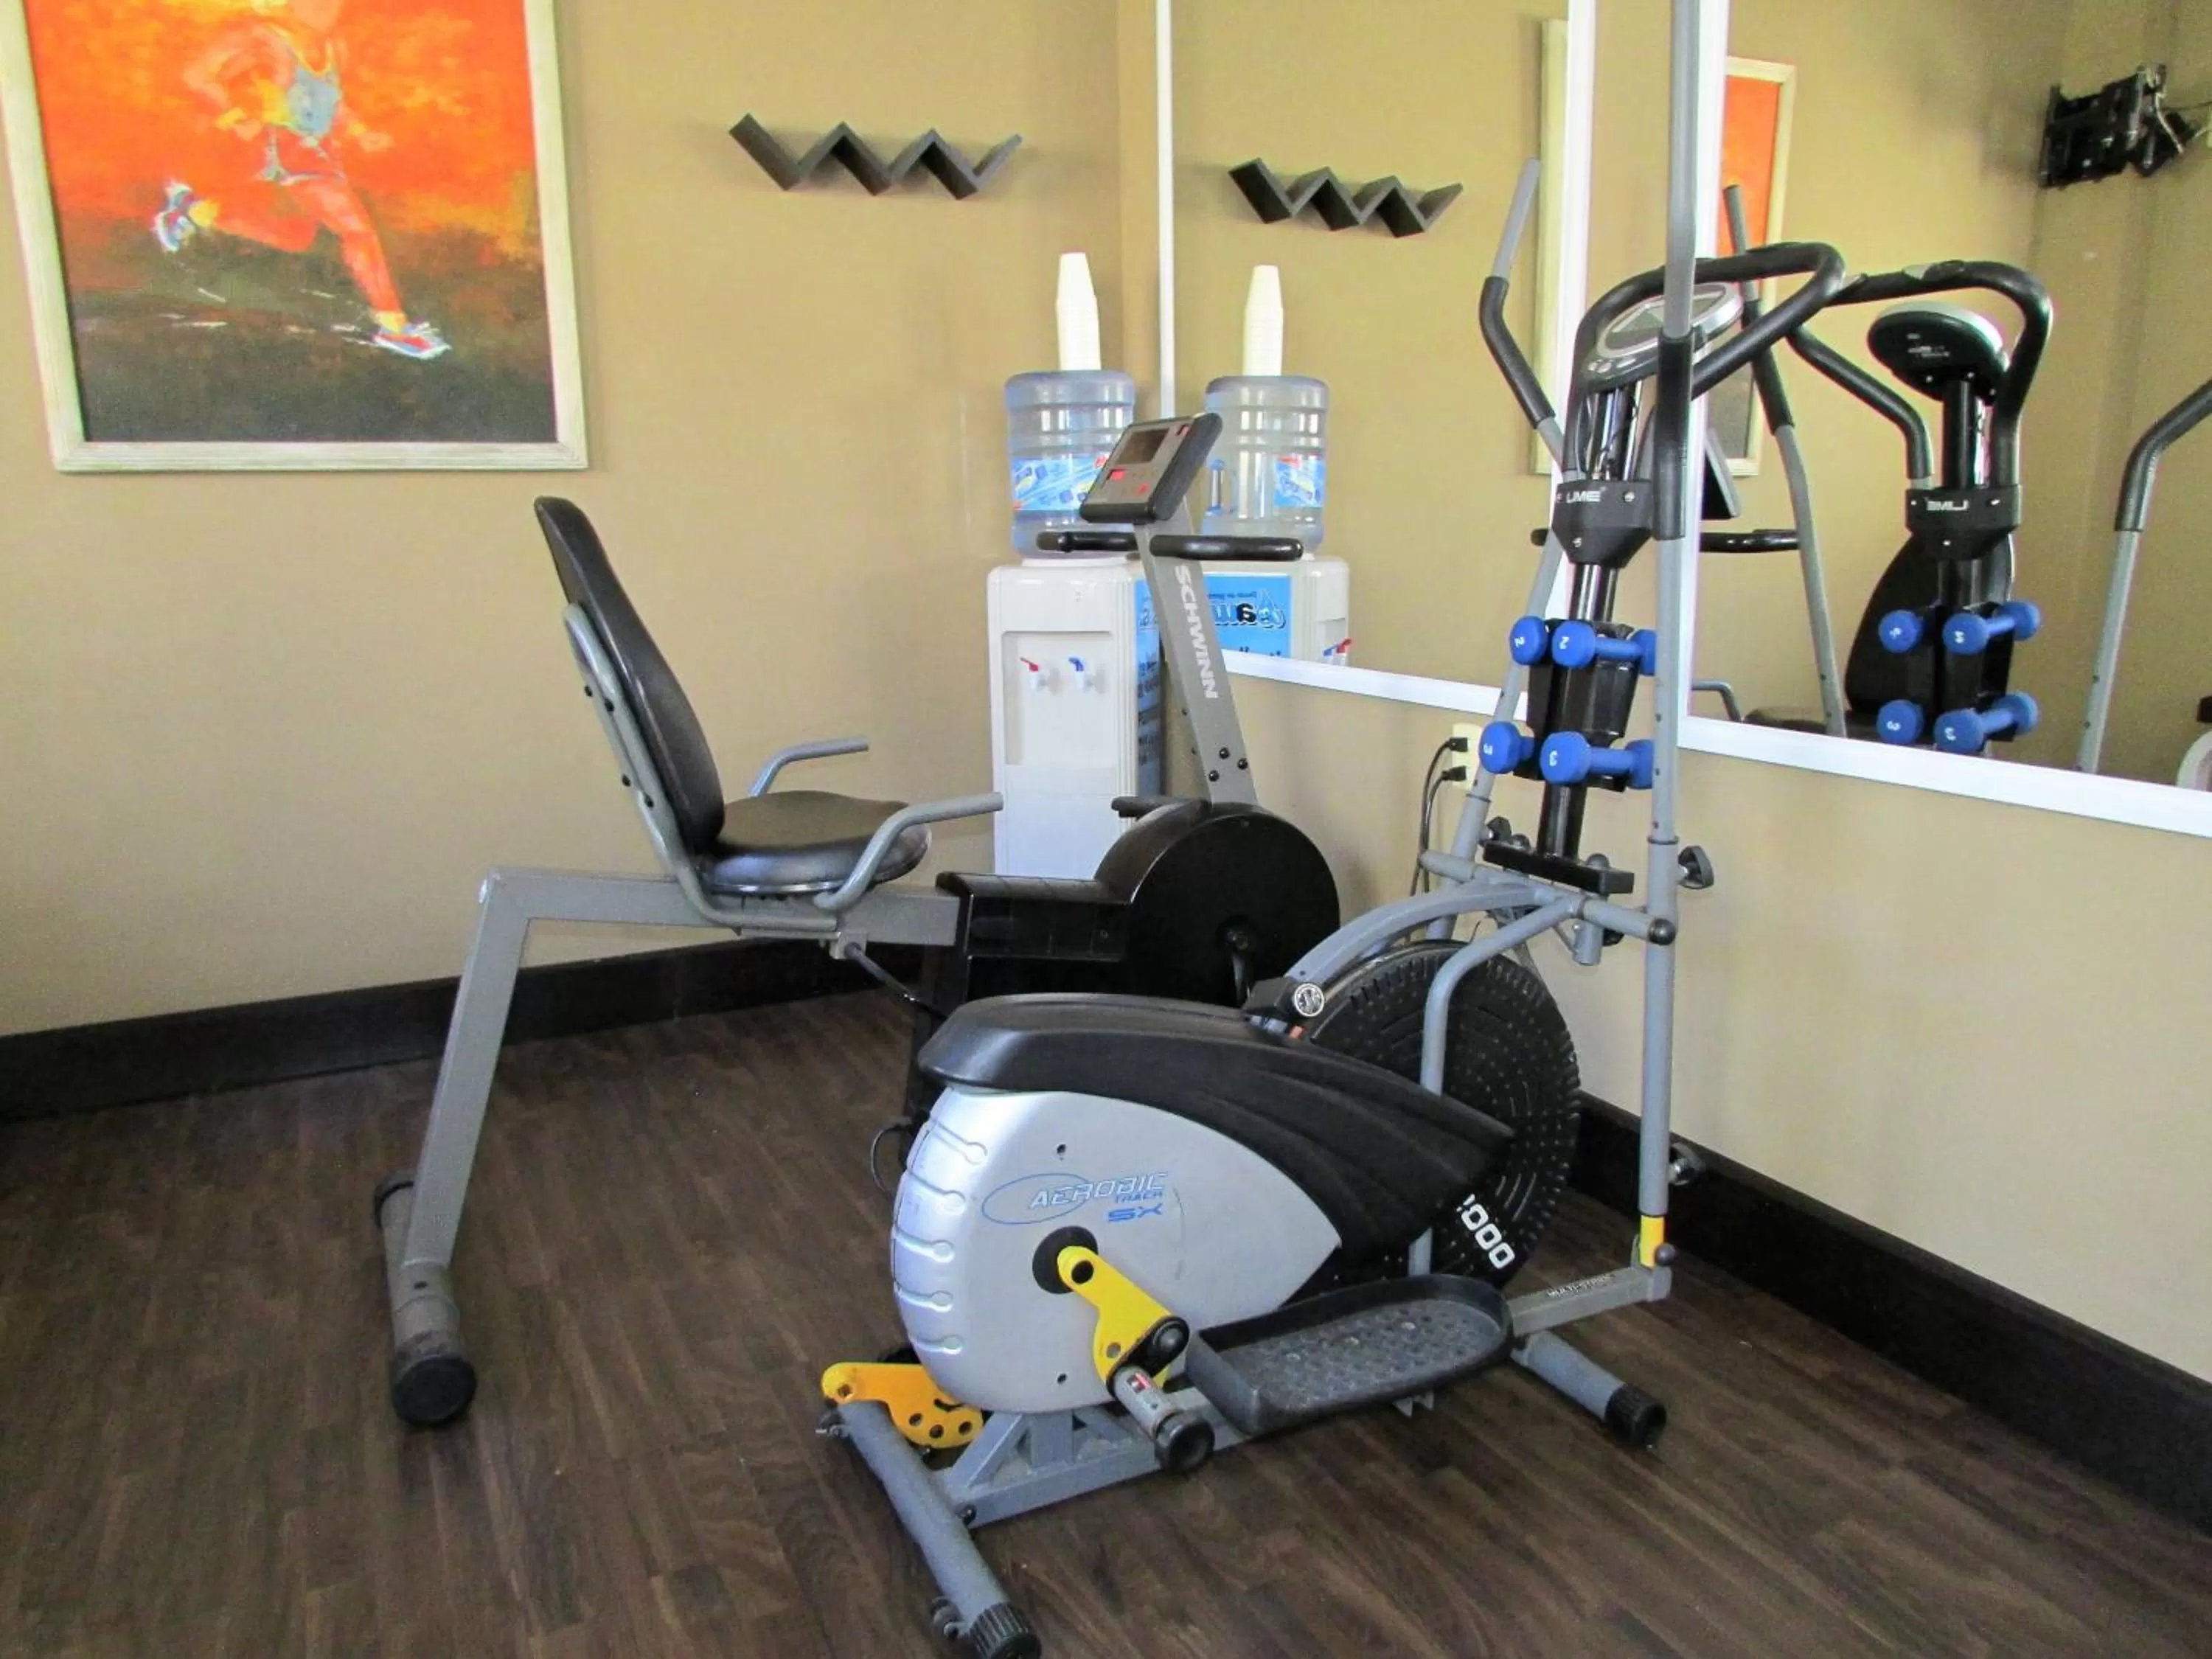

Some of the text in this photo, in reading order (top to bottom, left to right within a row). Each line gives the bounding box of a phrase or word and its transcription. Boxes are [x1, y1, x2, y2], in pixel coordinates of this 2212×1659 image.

[1175, 565, 1219, 698] SCHWINN
[1028, 1172, 1168, 1209] AEROBIC
[1108, 1203, 1163, 1222] SX
[1456, 1194, 1515, 1269] 000
